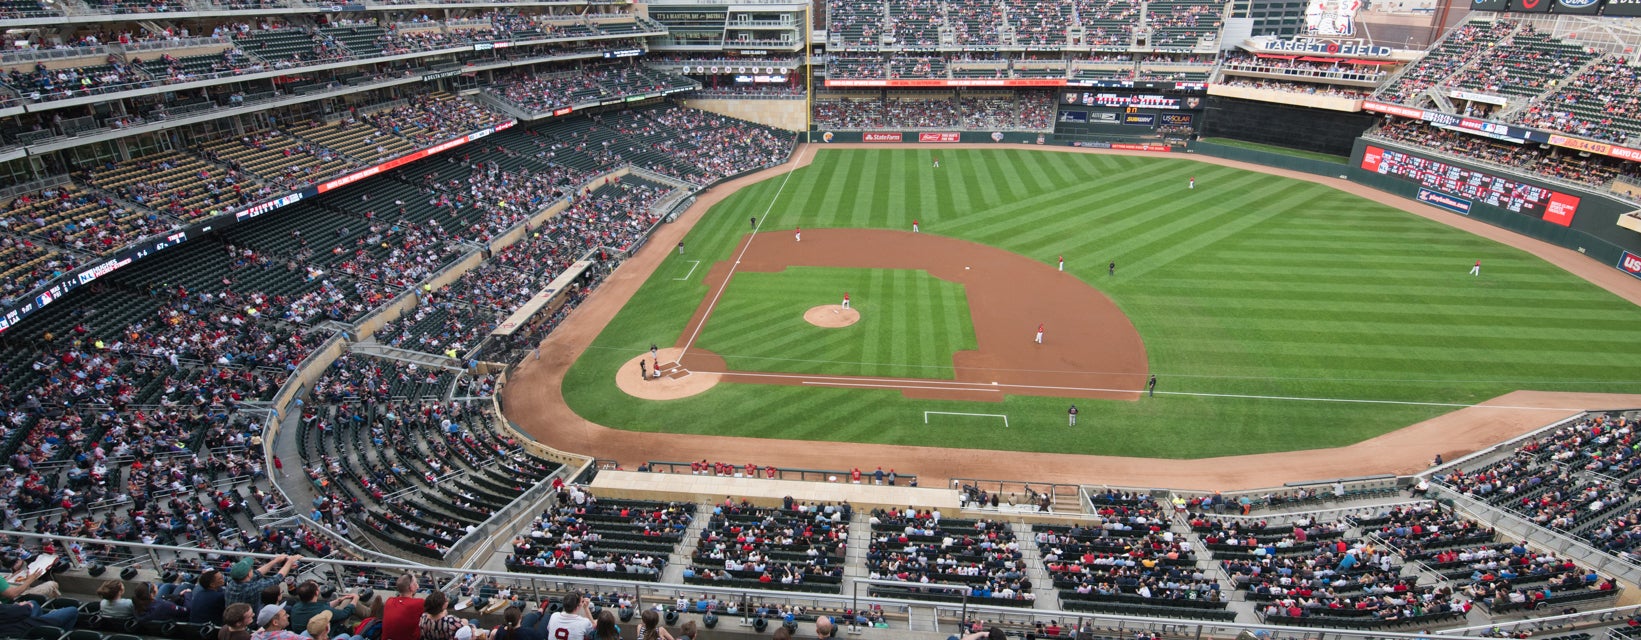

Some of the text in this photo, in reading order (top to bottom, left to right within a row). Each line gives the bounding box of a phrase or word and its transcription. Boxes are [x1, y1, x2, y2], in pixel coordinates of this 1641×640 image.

[1265, 41, 1391, 56] TARGET FIELD
[1612, 148, 1631, 157] MAYO
[92, 259, 118, 272] HUGHES
[554, 628, 569, 640] 9
